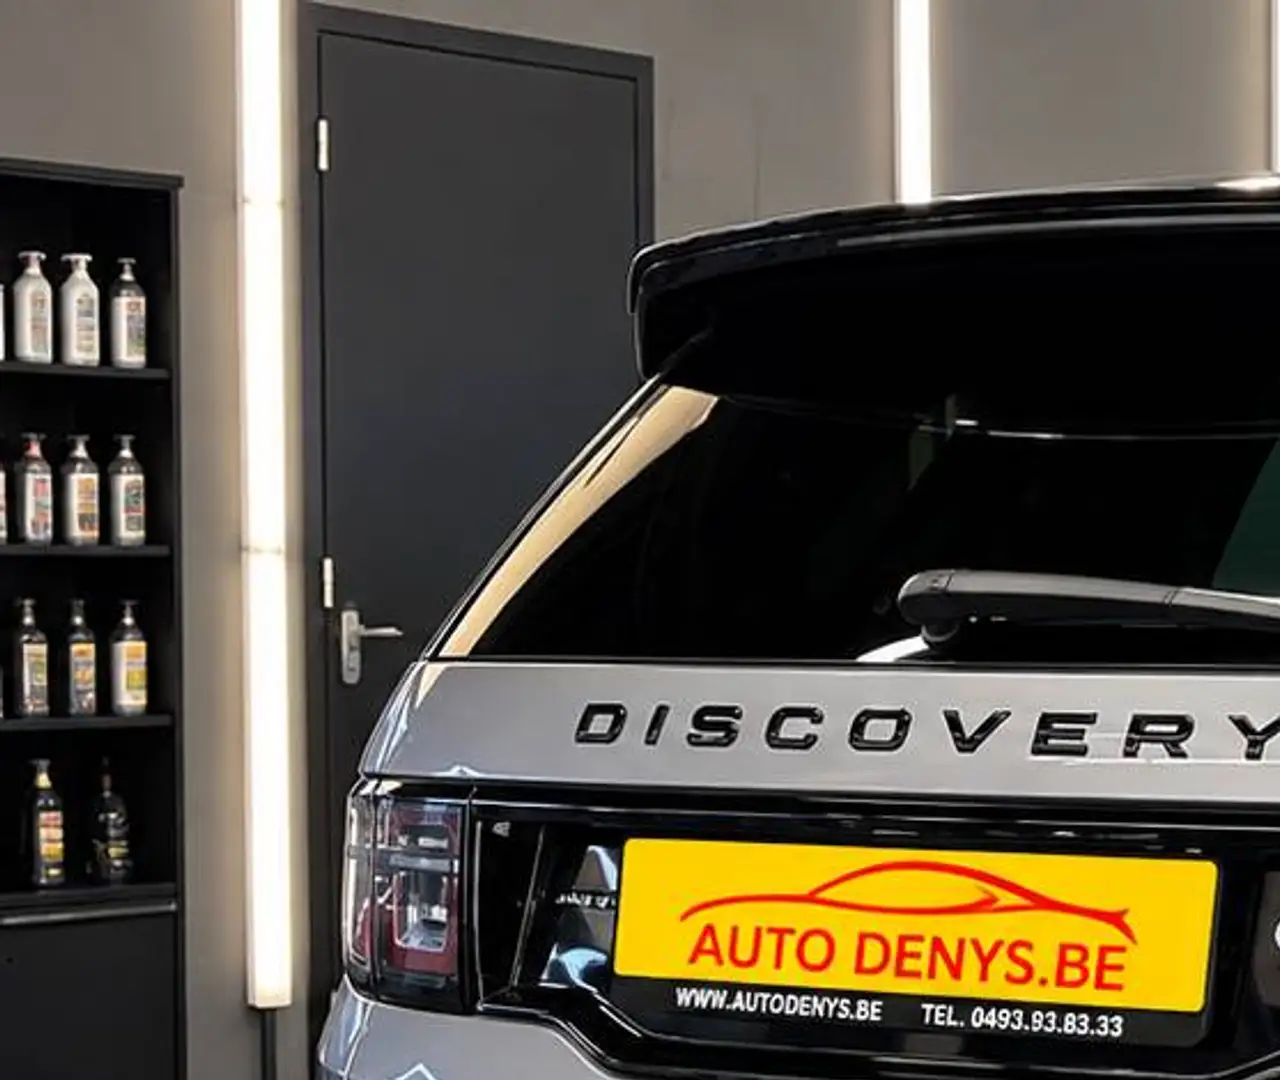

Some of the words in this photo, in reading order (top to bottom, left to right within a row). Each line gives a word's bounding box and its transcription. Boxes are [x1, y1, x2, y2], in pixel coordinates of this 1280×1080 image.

[687, 922, 837, 974] AUTO
[852, 930, 1129, 992] DENYS.BE
[674, 986, 885, 1022] WWW.AUTODENYS.BE
[920, 1002, 966, 1028] TEL.
[969, 1005, 1125, 1038] 0493.93.83.33
